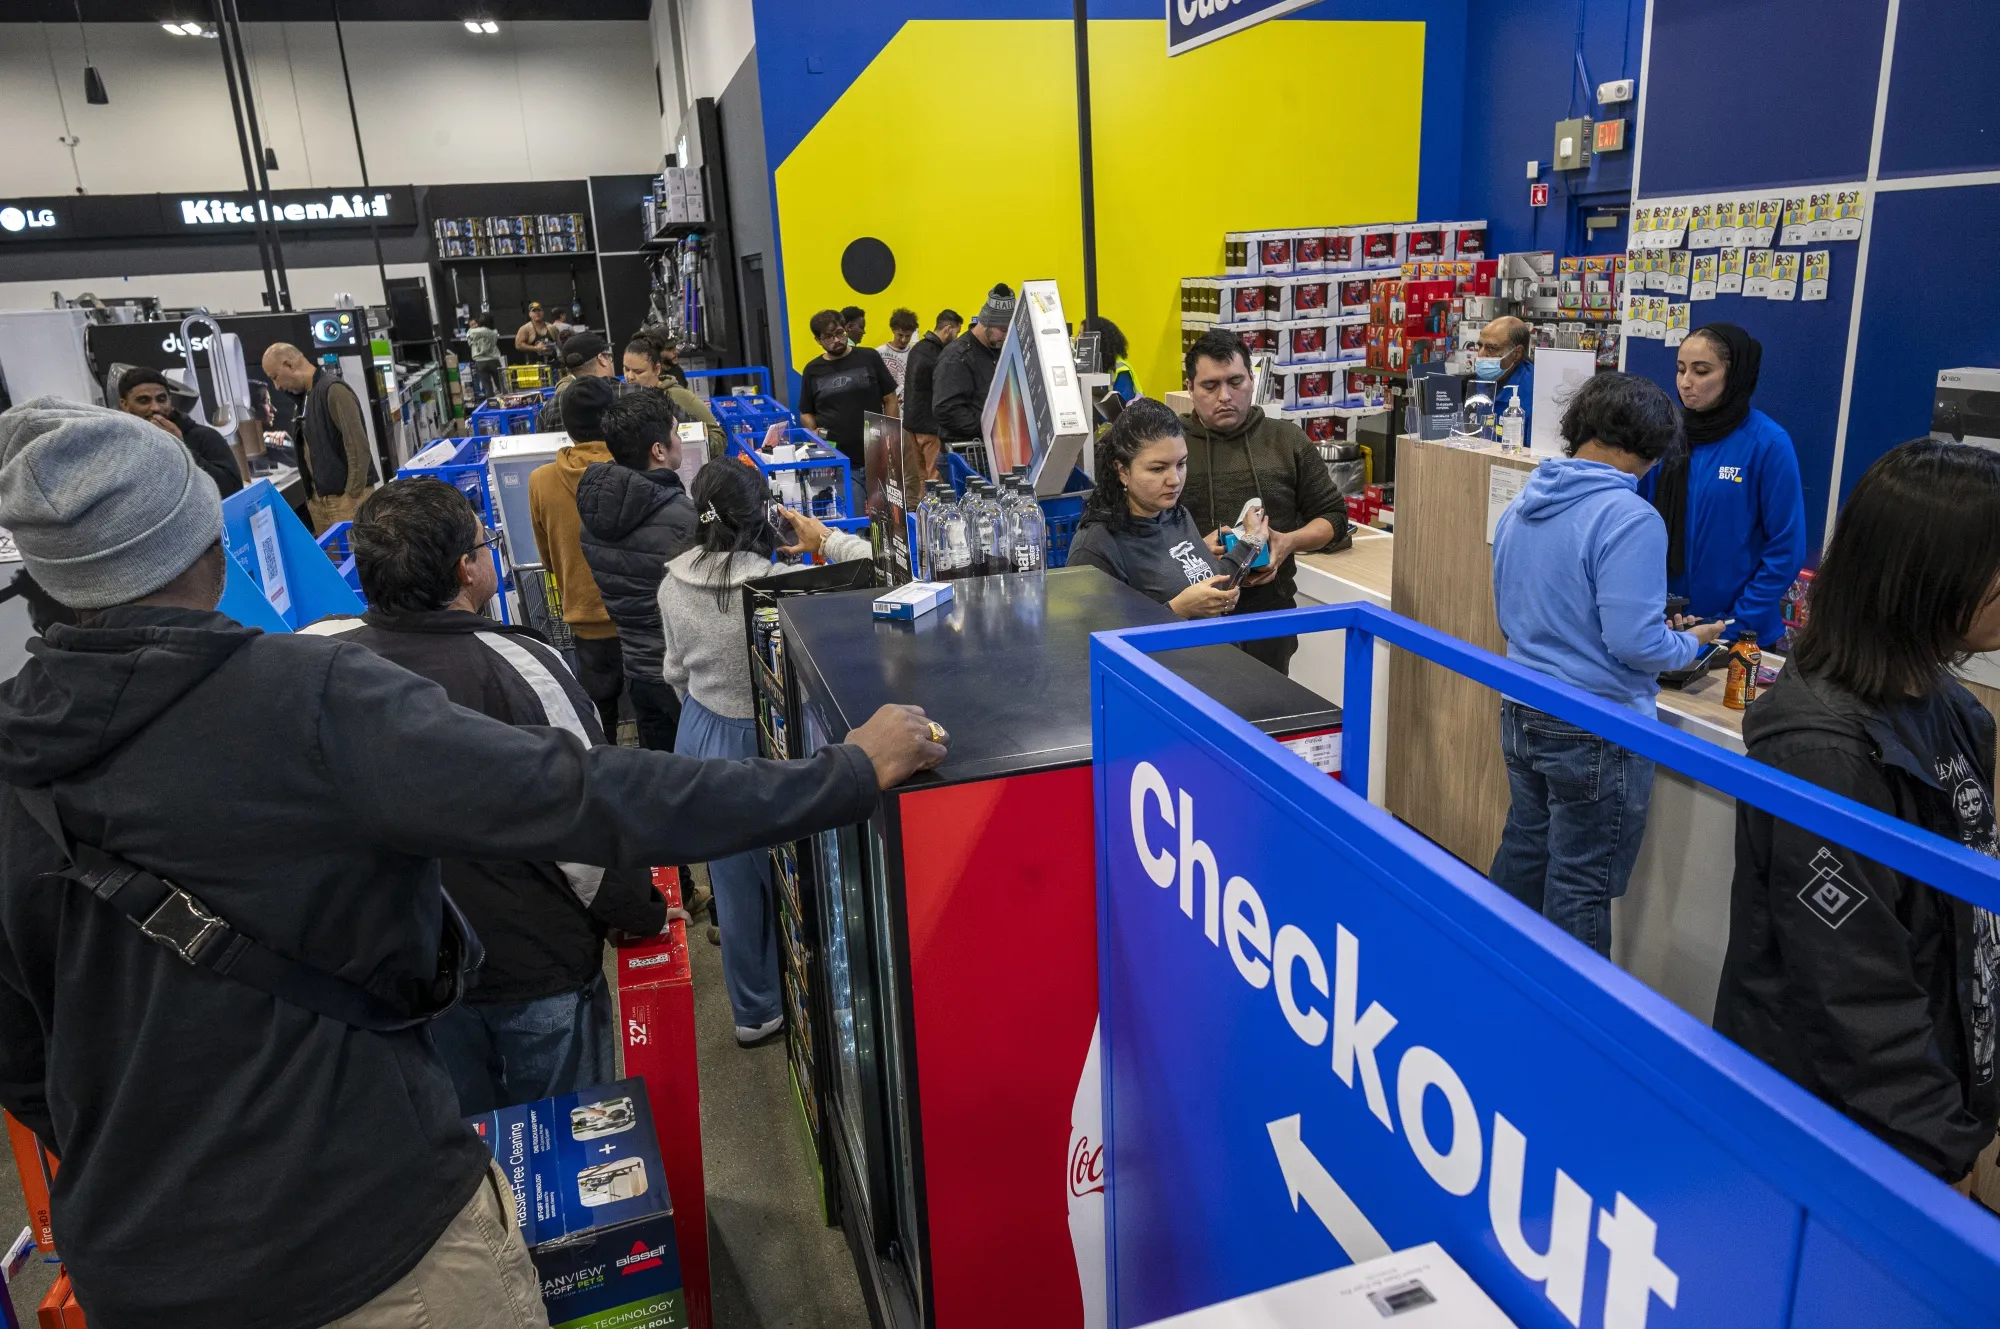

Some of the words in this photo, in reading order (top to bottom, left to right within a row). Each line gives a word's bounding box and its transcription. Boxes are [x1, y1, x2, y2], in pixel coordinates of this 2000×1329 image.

[1597, 122, 1619, 148] EXIT
[27, 209, 56, 227] LG
[182, 194, 388, 224] KitchenAid
[1719, 466, 1741, 474] BEST
[1719, 472, 1735, 481] BUY
[1016, 544, 1030, 573] art
[1130, 761, 1679, 1329] Checkout
[509, 1122, 525, 1165] Cleaning
[41, 1227, 53, 1244] fire
[540, 1264, 604, 1292] ANVIEW
[542, 1282, 574, 1298] T-OFF
[577, 1277, 596, 1289] PET
[593, 1299, 674, 1329] TECHNOLOGY
[648, 1316, 675, 1329] ROLL
